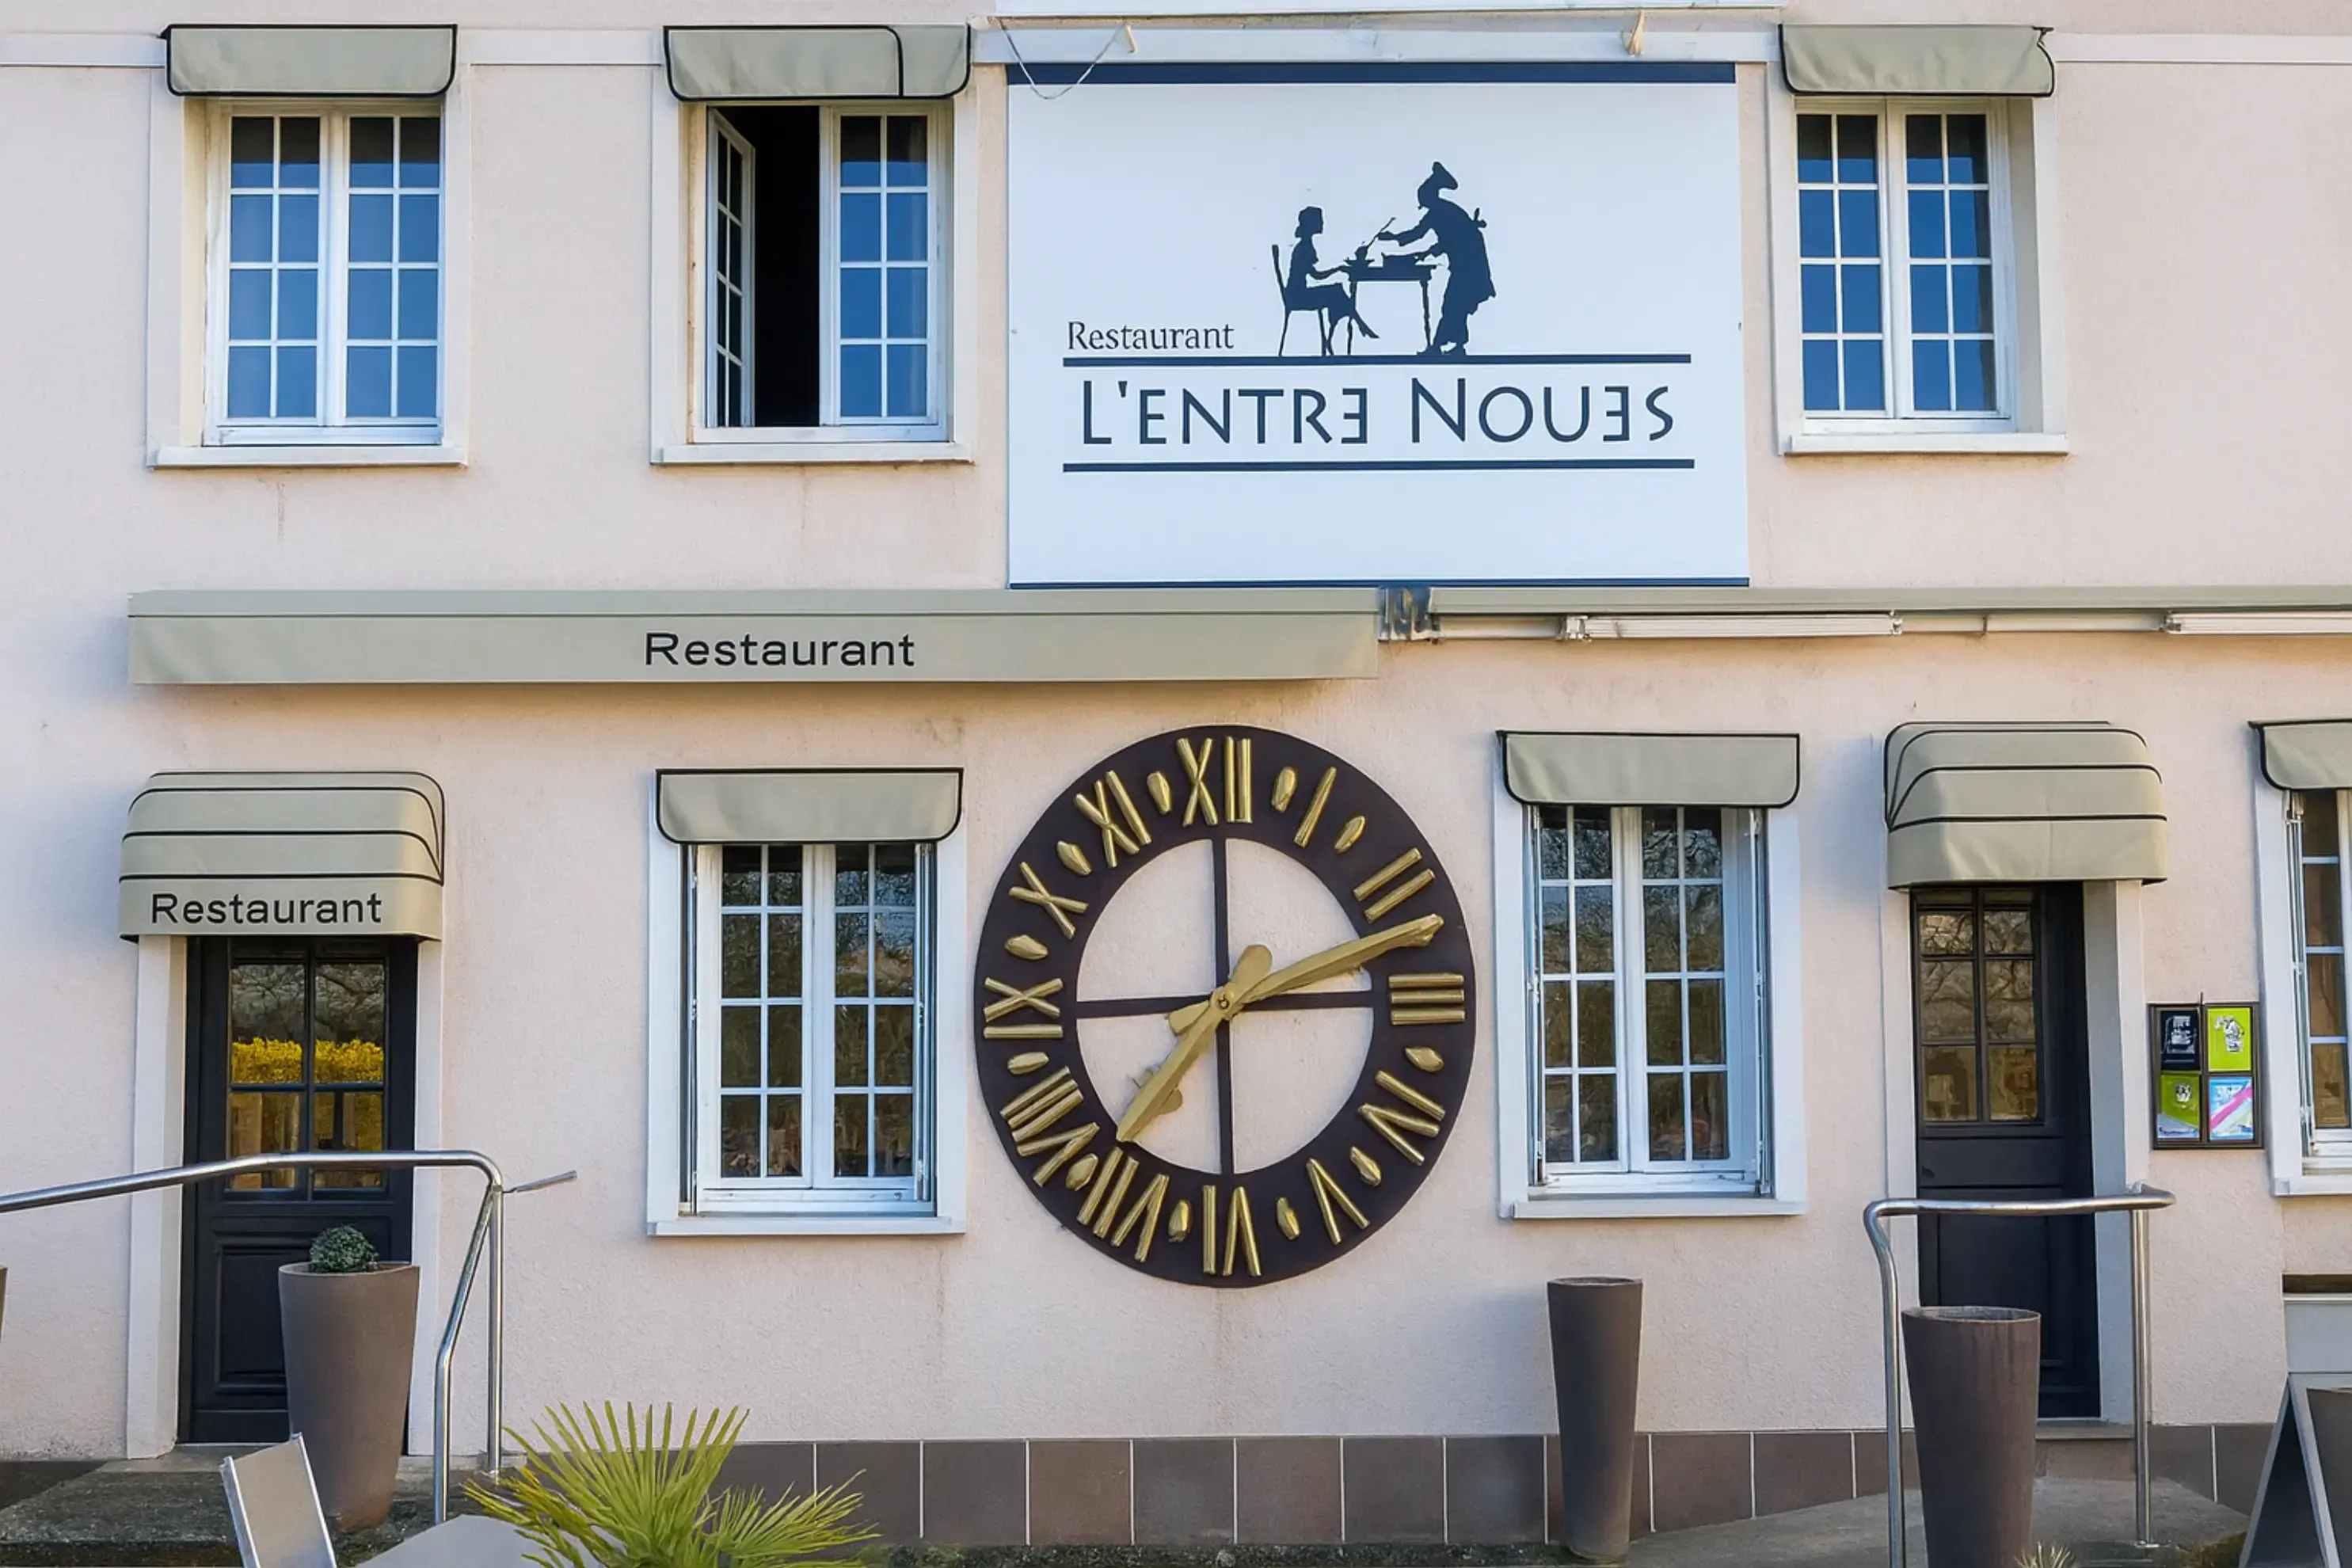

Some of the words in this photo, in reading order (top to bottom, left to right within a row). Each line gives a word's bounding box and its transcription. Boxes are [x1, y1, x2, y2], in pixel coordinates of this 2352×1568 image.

[1068, 322, 1235, 350] Restaurant
[645, 632, 915, 667] Restaurant
[1177, 736, 1253, 826] XII
[1074, 770, 1151, 868] XI
[152, 892, 382, 924] Restaurant
[1009, 861, 1089, 938] X
[1353, 847, 1436, 922] II
[984, 978, 1064, 1039] IX
[1388, 972, 1466, 1026] III
